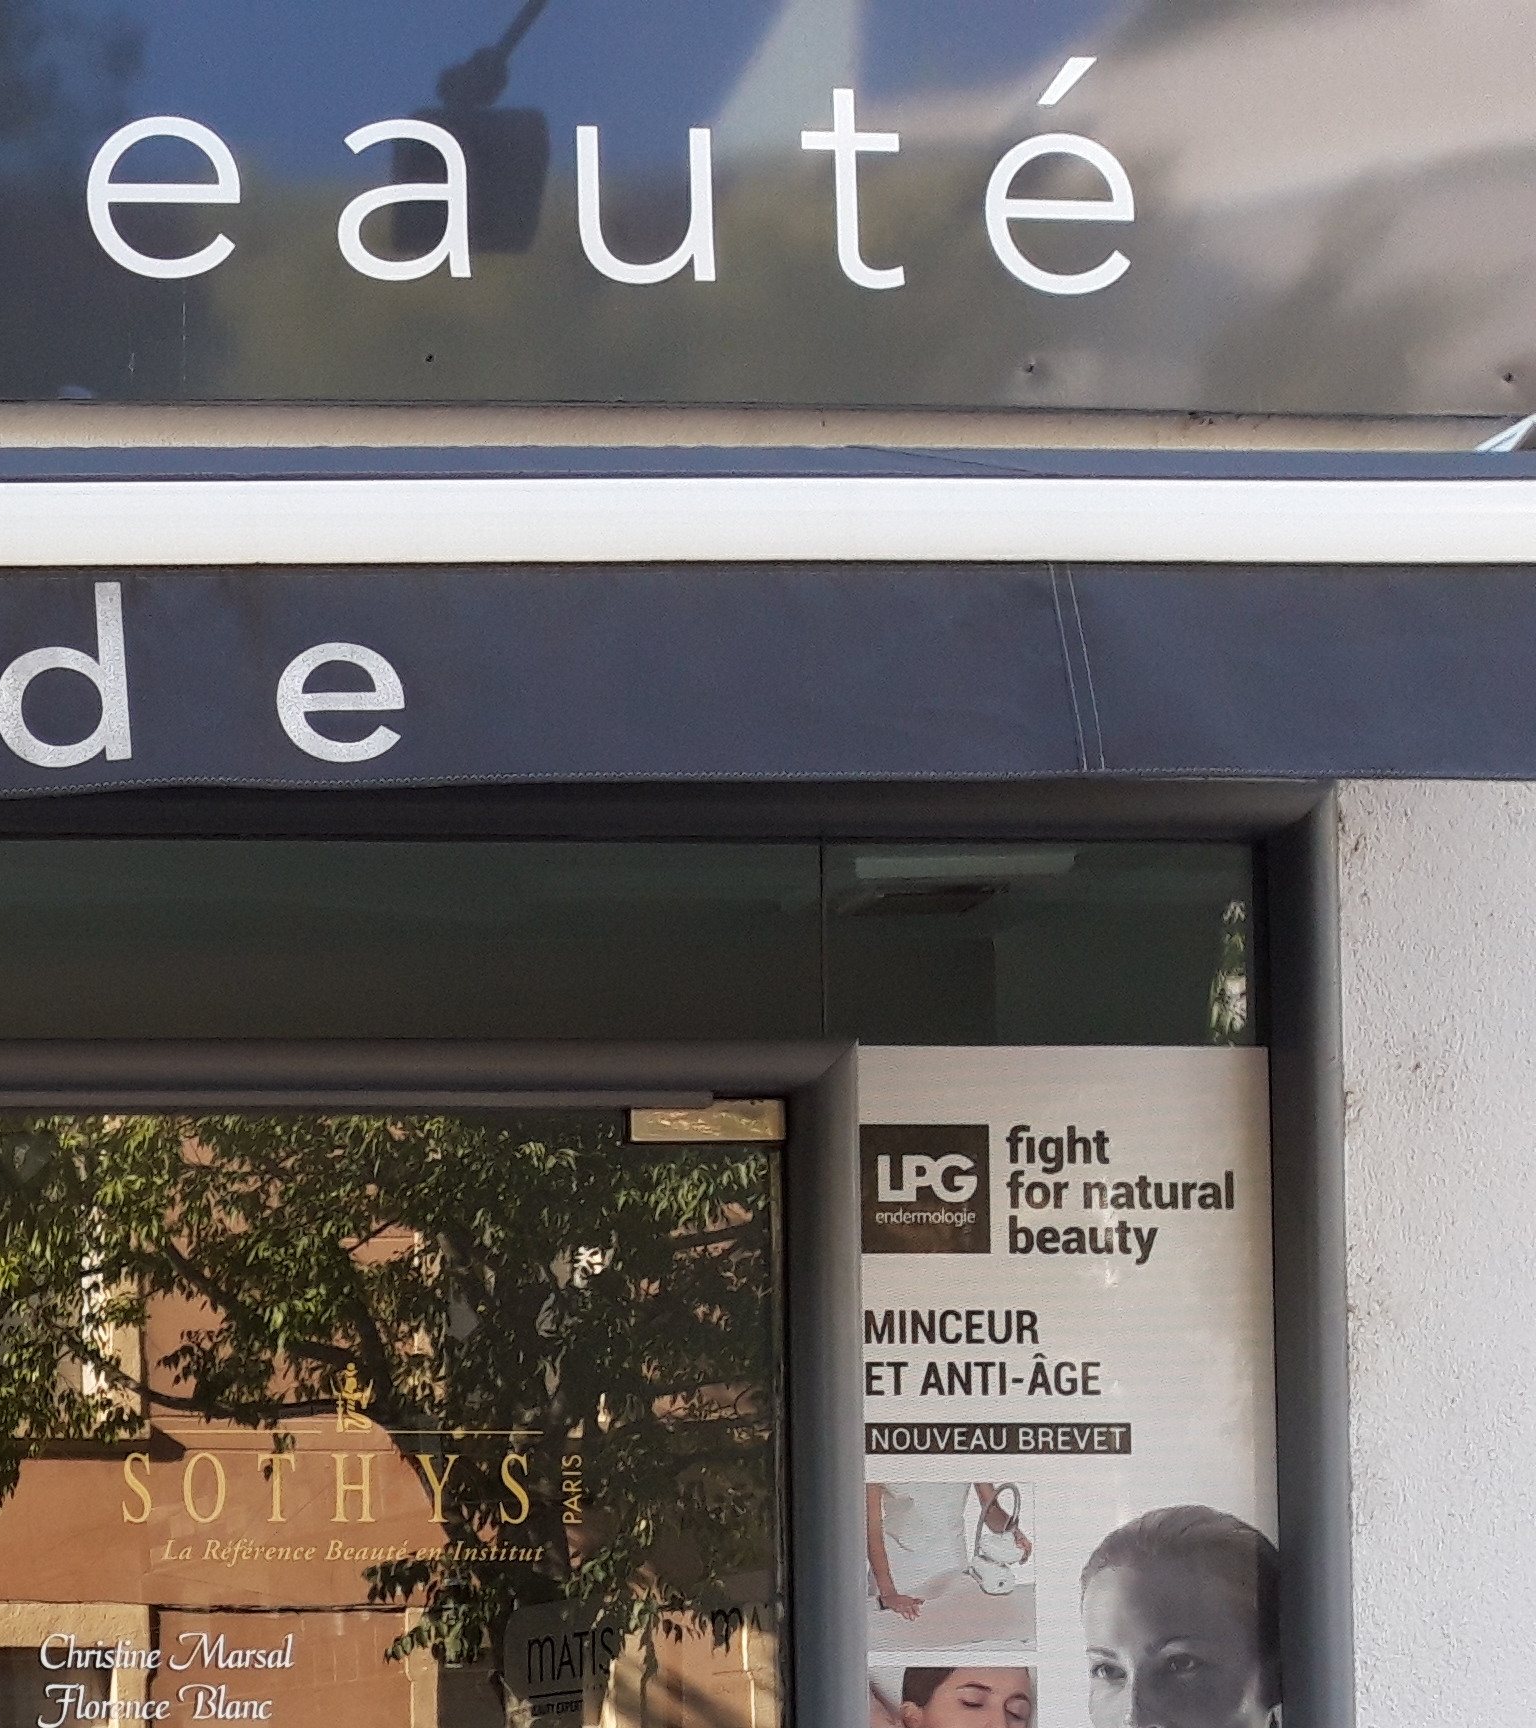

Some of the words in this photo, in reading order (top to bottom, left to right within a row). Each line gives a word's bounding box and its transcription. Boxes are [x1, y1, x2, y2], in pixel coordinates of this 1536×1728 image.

[1007, 1125, 1110, 1175] fight
[877, 1154, 978, 1203] LPG
[1007, 1170, 1069, 1210] for
[1083, 1170, 1235, 1211] natural
[876, 1209, 976, 1227] endermologie
[1008, 1215, 1158, 1265] beauty
[864, 1309, 1040, 1344] MINCEUR
[865, 1361, 908, 1396] ET
[920, 1353, 1101, 1396] ANTI-ÂGE
[871, 1428, 1007, 1451] NOUVEAU
[1018, 1427, 1126, 1451] BREVET
[122, 1451, 530, 1525] SOTHYS
[562, 1455, 582, 1524] PARIS
[163, 1539, 191, 1560] La
[202, 1538, 315, 1567] Référence
[325, 1538, 407, 1562] Beauté
[416, 1545, 443, 1562] en
[453, 1540, 544, 1563] Institut
[40, 1633, 162, 1670] Christine
[169, 1632, 294, 1670] Marsal
[37, 1683, 171, 1728] Florence
[178, 1683, 273, 1720] Blanc
